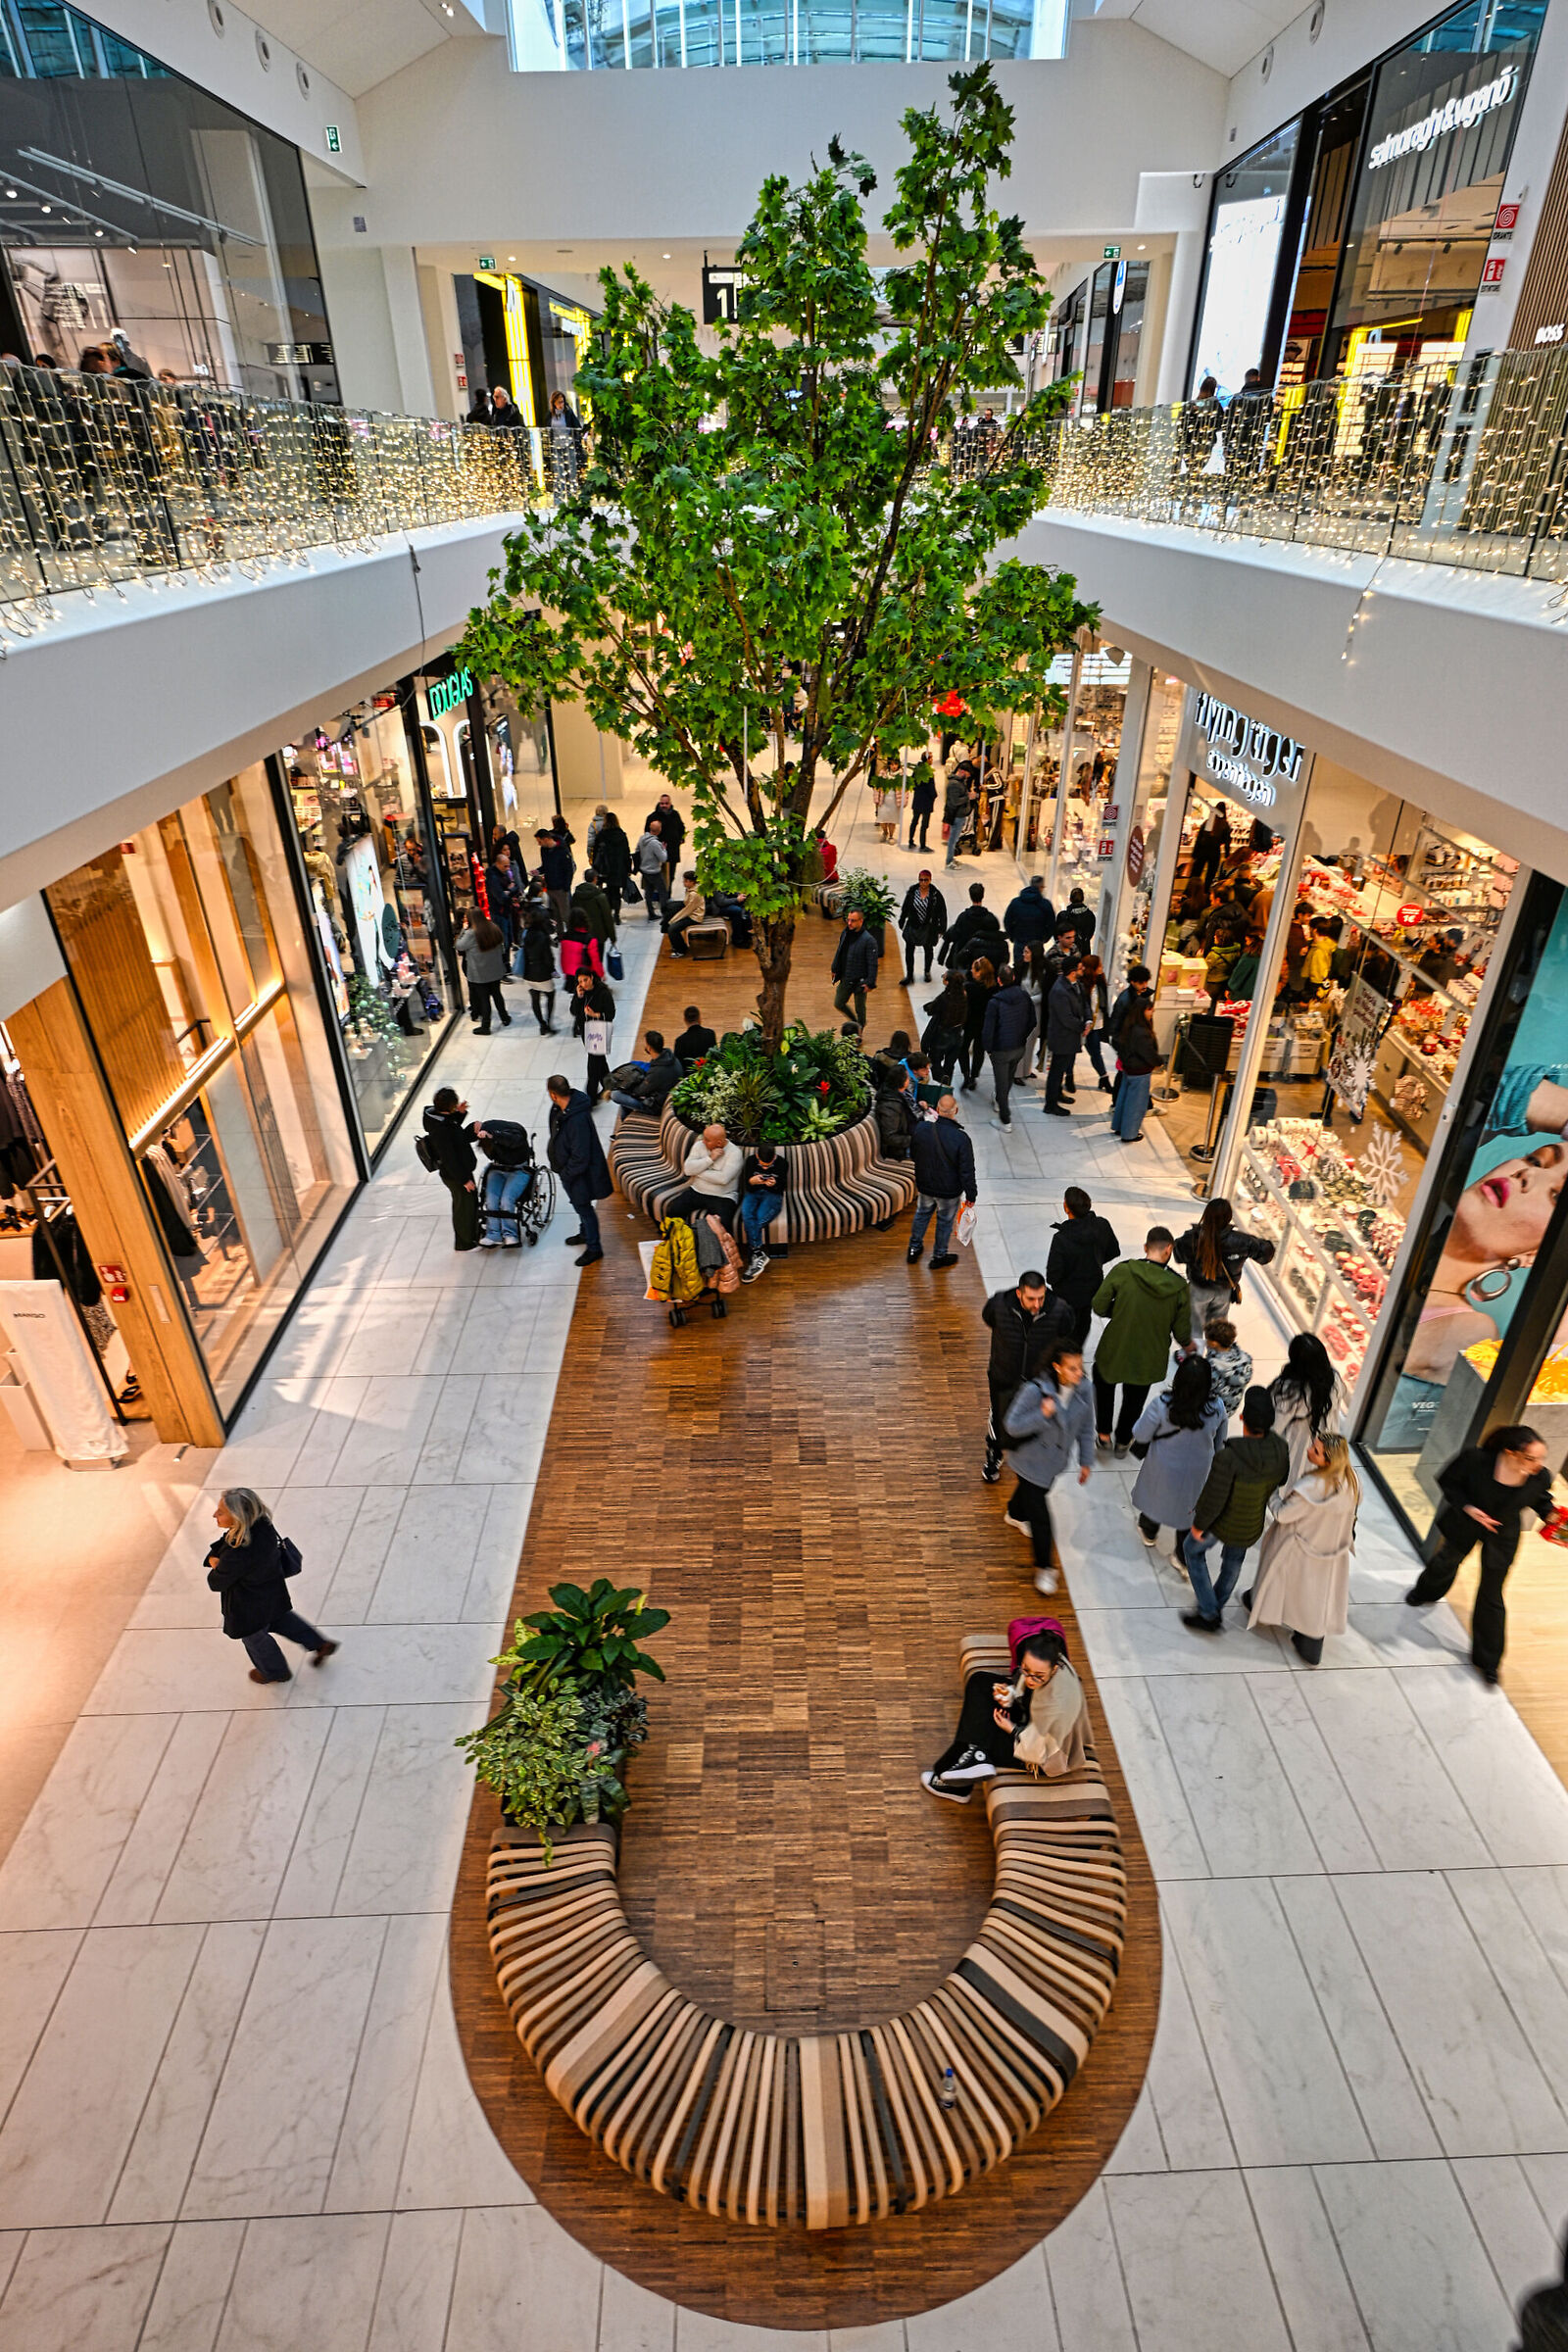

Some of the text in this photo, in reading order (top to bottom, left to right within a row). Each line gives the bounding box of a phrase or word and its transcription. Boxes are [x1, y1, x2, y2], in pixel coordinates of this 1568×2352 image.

[1535, 323, 1565, 344] BOSS
[429, 666, 473, 720] DOUGLAS
[1195, 692, 1305, 782] flying tiger
